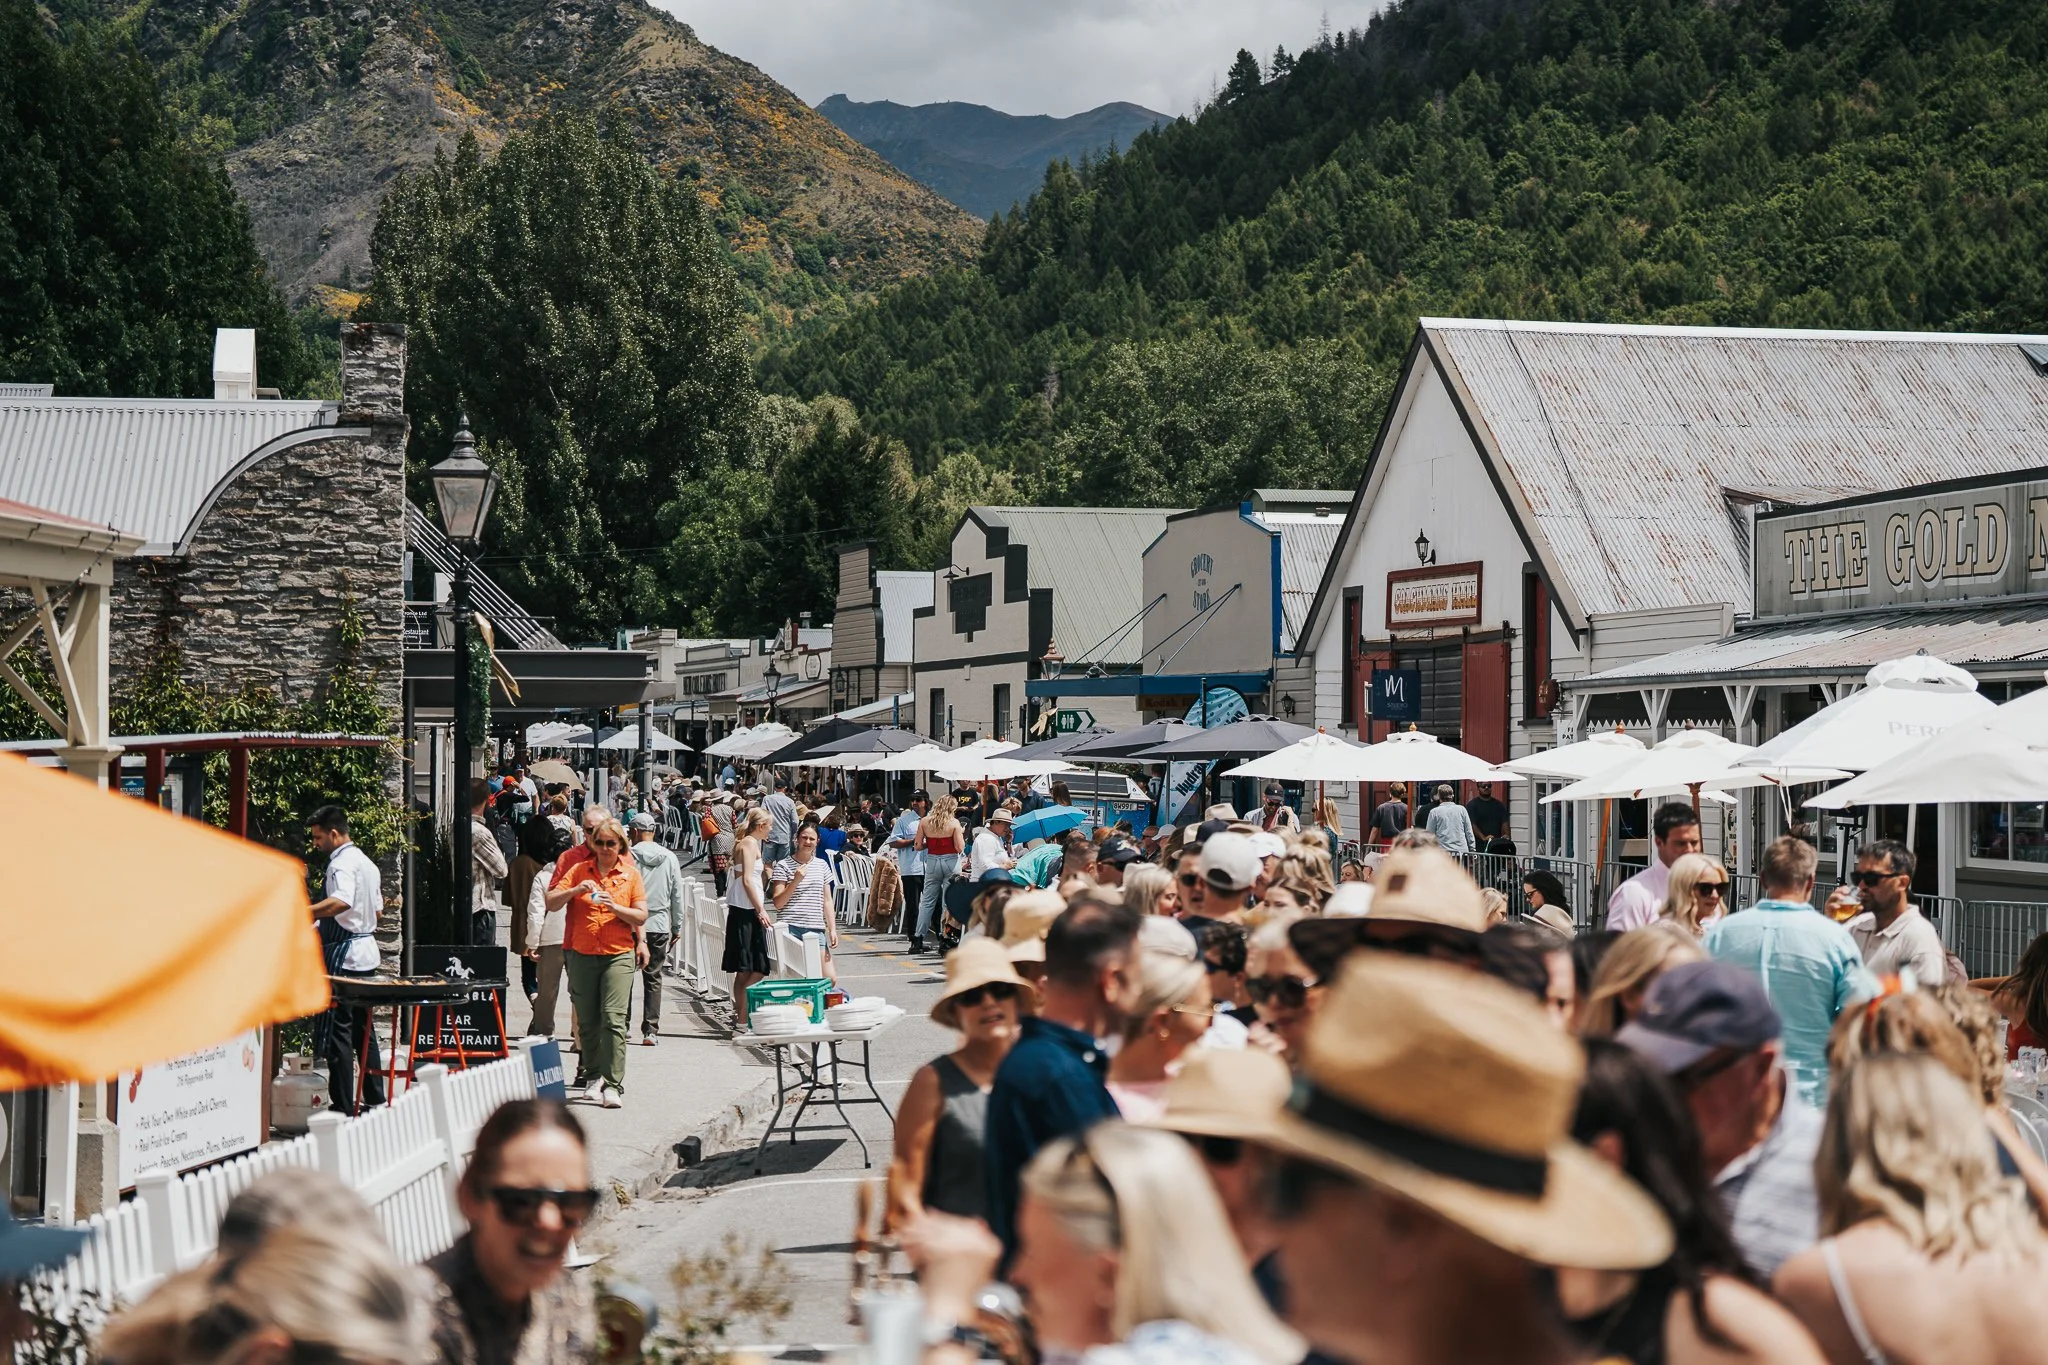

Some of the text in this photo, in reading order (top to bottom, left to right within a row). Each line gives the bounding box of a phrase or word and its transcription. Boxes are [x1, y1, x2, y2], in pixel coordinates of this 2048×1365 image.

[1784, 520, 1869, 595] THE
[1884, 502, 2009, 588] GOLD
[1193, 588, 1211, 611] STORE
[1385, 674, 1405, 702] M
[418, 1034, 500, 1045] RETAURANT
[140, 1115, 150, 1130] Pick
[162, 1109, 174, 1124] Own
[174, 1105, 189, 1120] White
[139, 1137, 150, 1152] Real
